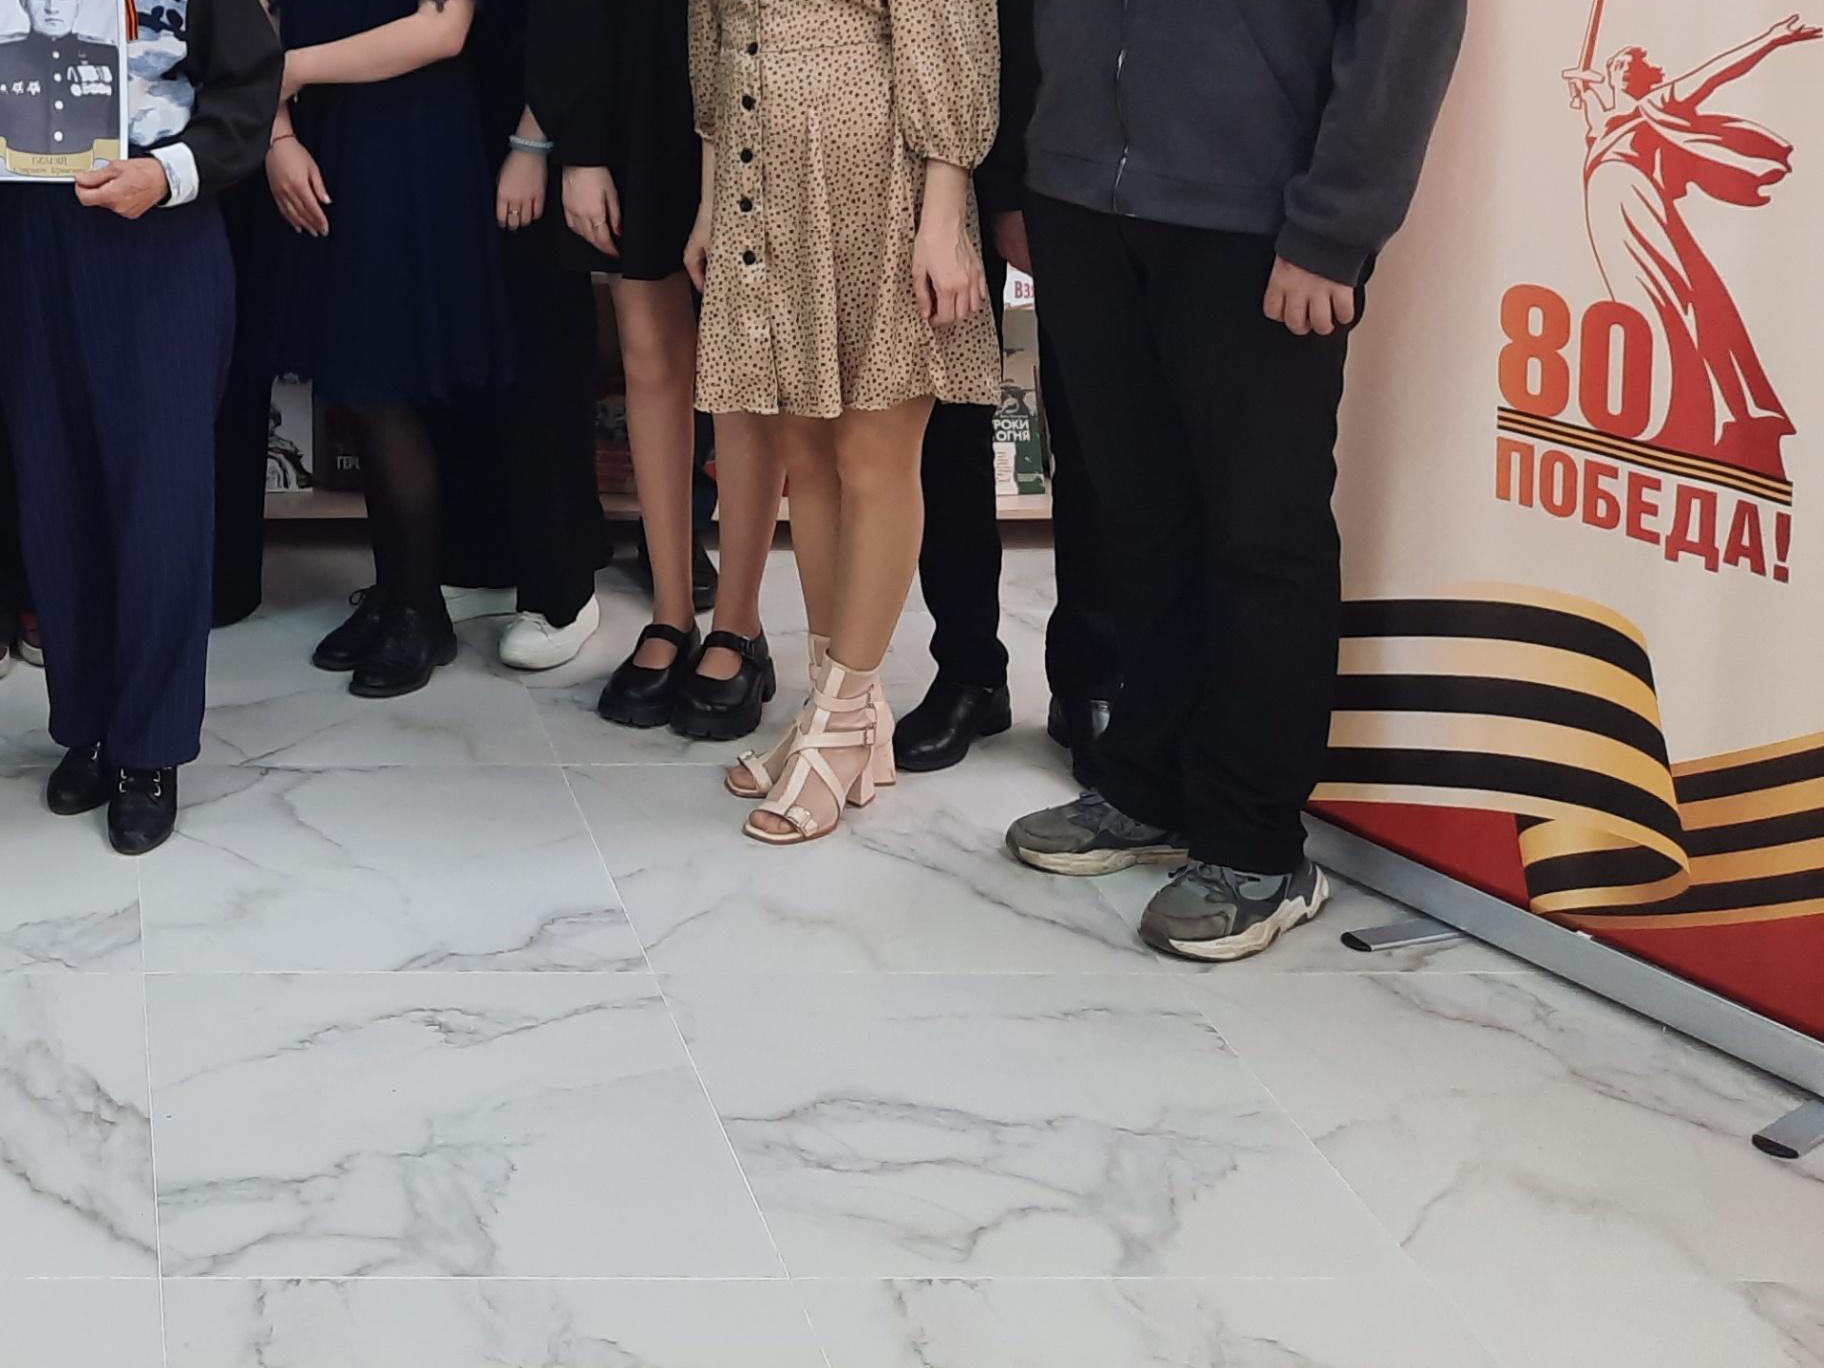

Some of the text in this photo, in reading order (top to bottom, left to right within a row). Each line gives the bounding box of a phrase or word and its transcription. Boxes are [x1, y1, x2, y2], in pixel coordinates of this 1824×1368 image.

[1499, 283, 1655, 439] 80
[996, 430, 1031, 442] ОГНЯ
[1496, 435, 1792, 584] ПОБЕДА!
